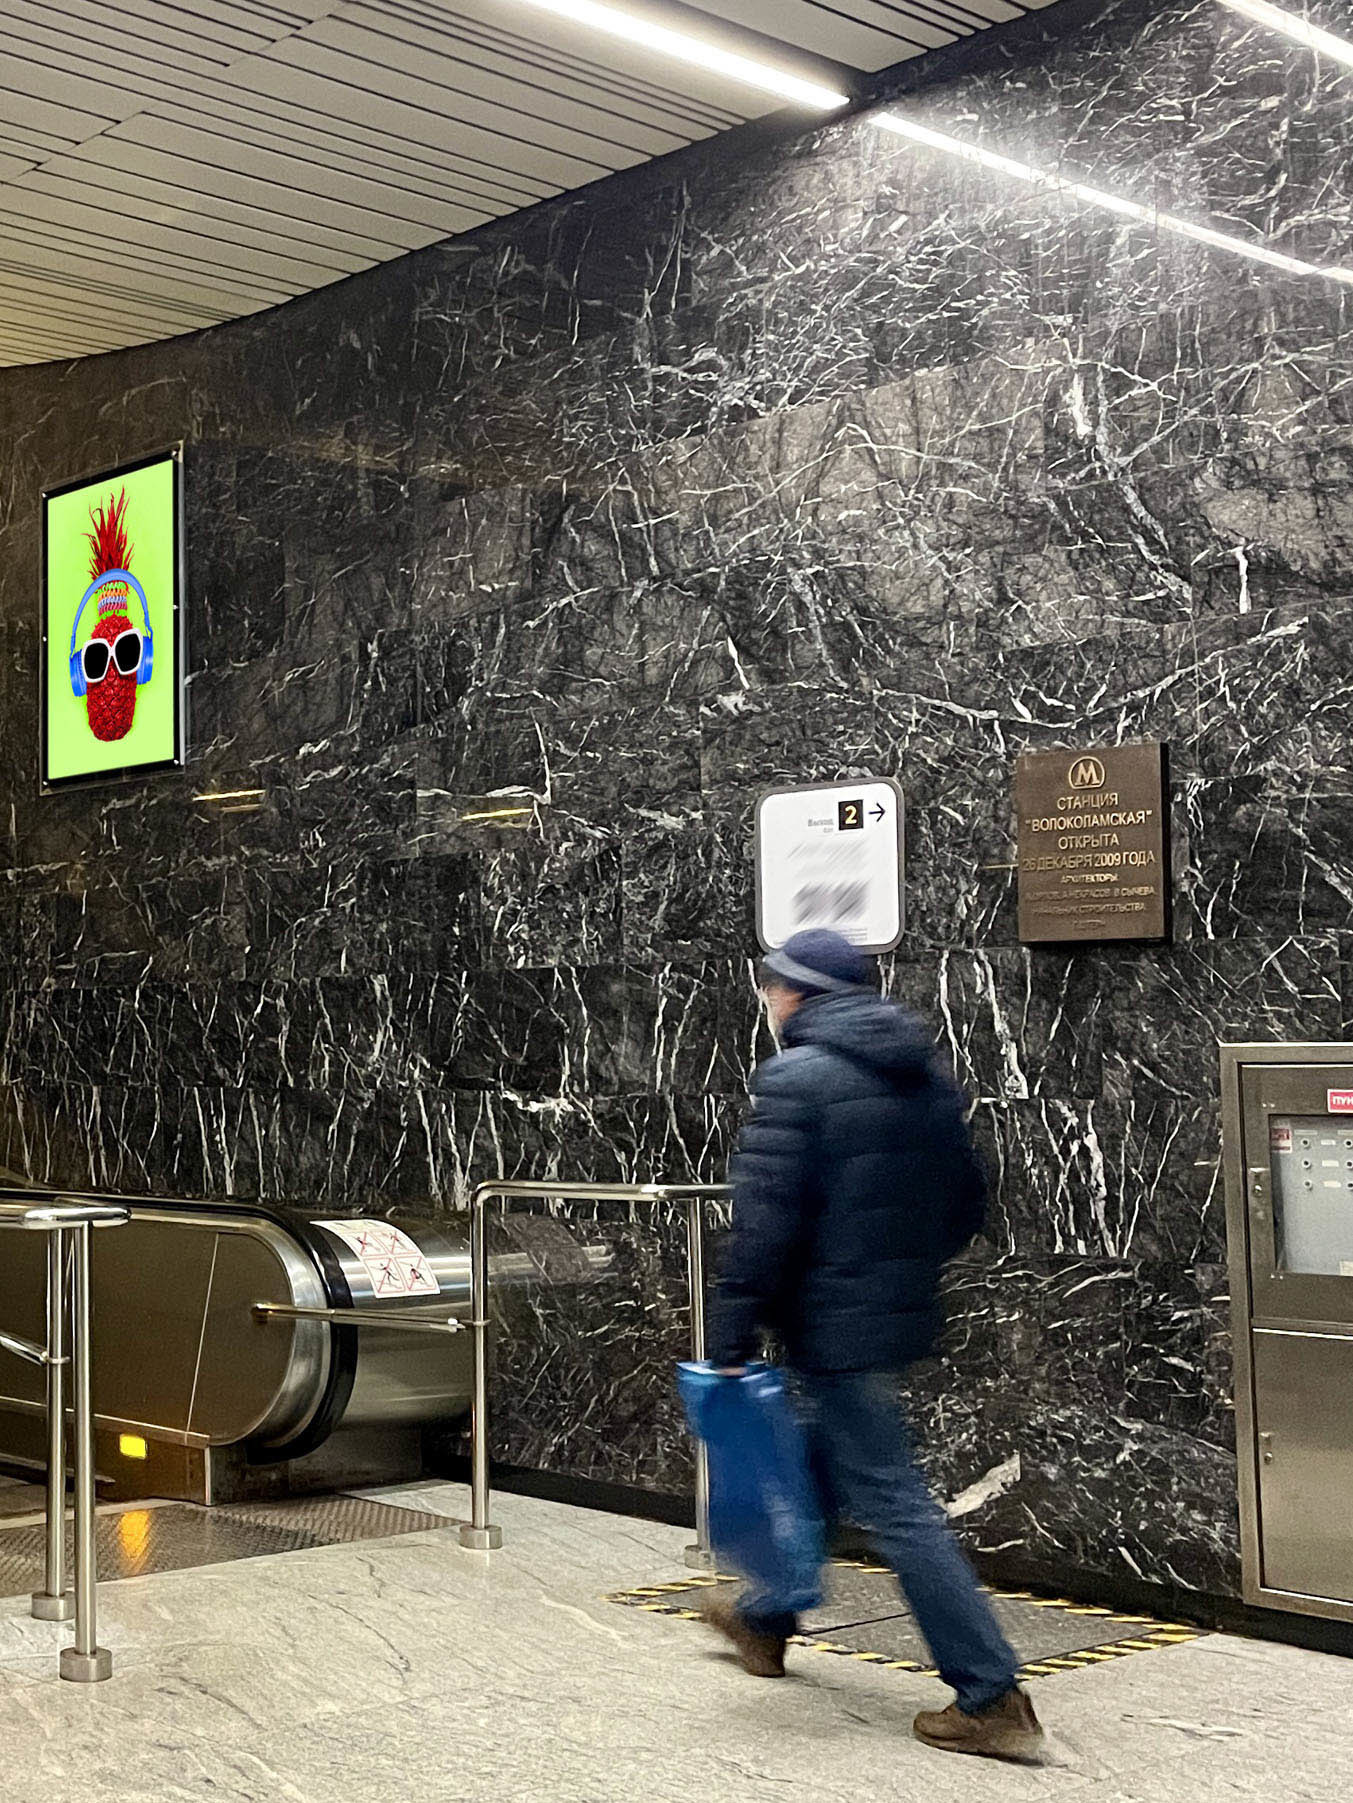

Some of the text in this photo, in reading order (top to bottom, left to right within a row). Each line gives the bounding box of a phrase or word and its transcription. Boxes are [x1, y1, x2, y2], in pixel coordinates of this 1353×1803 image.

[1056, 792, 1119, 811] СТАНЦИЯ
[844, 805, 858, 825] 2
[1025, 809, 1153, 832] "ВОЛОКОЛАМСКАЯ"
[1057, 833, 1120, 850] ОТКРЫТА
[1022, 850, 1156, 872] 26 ДЕКАБРЯ 2009 ГОДА
